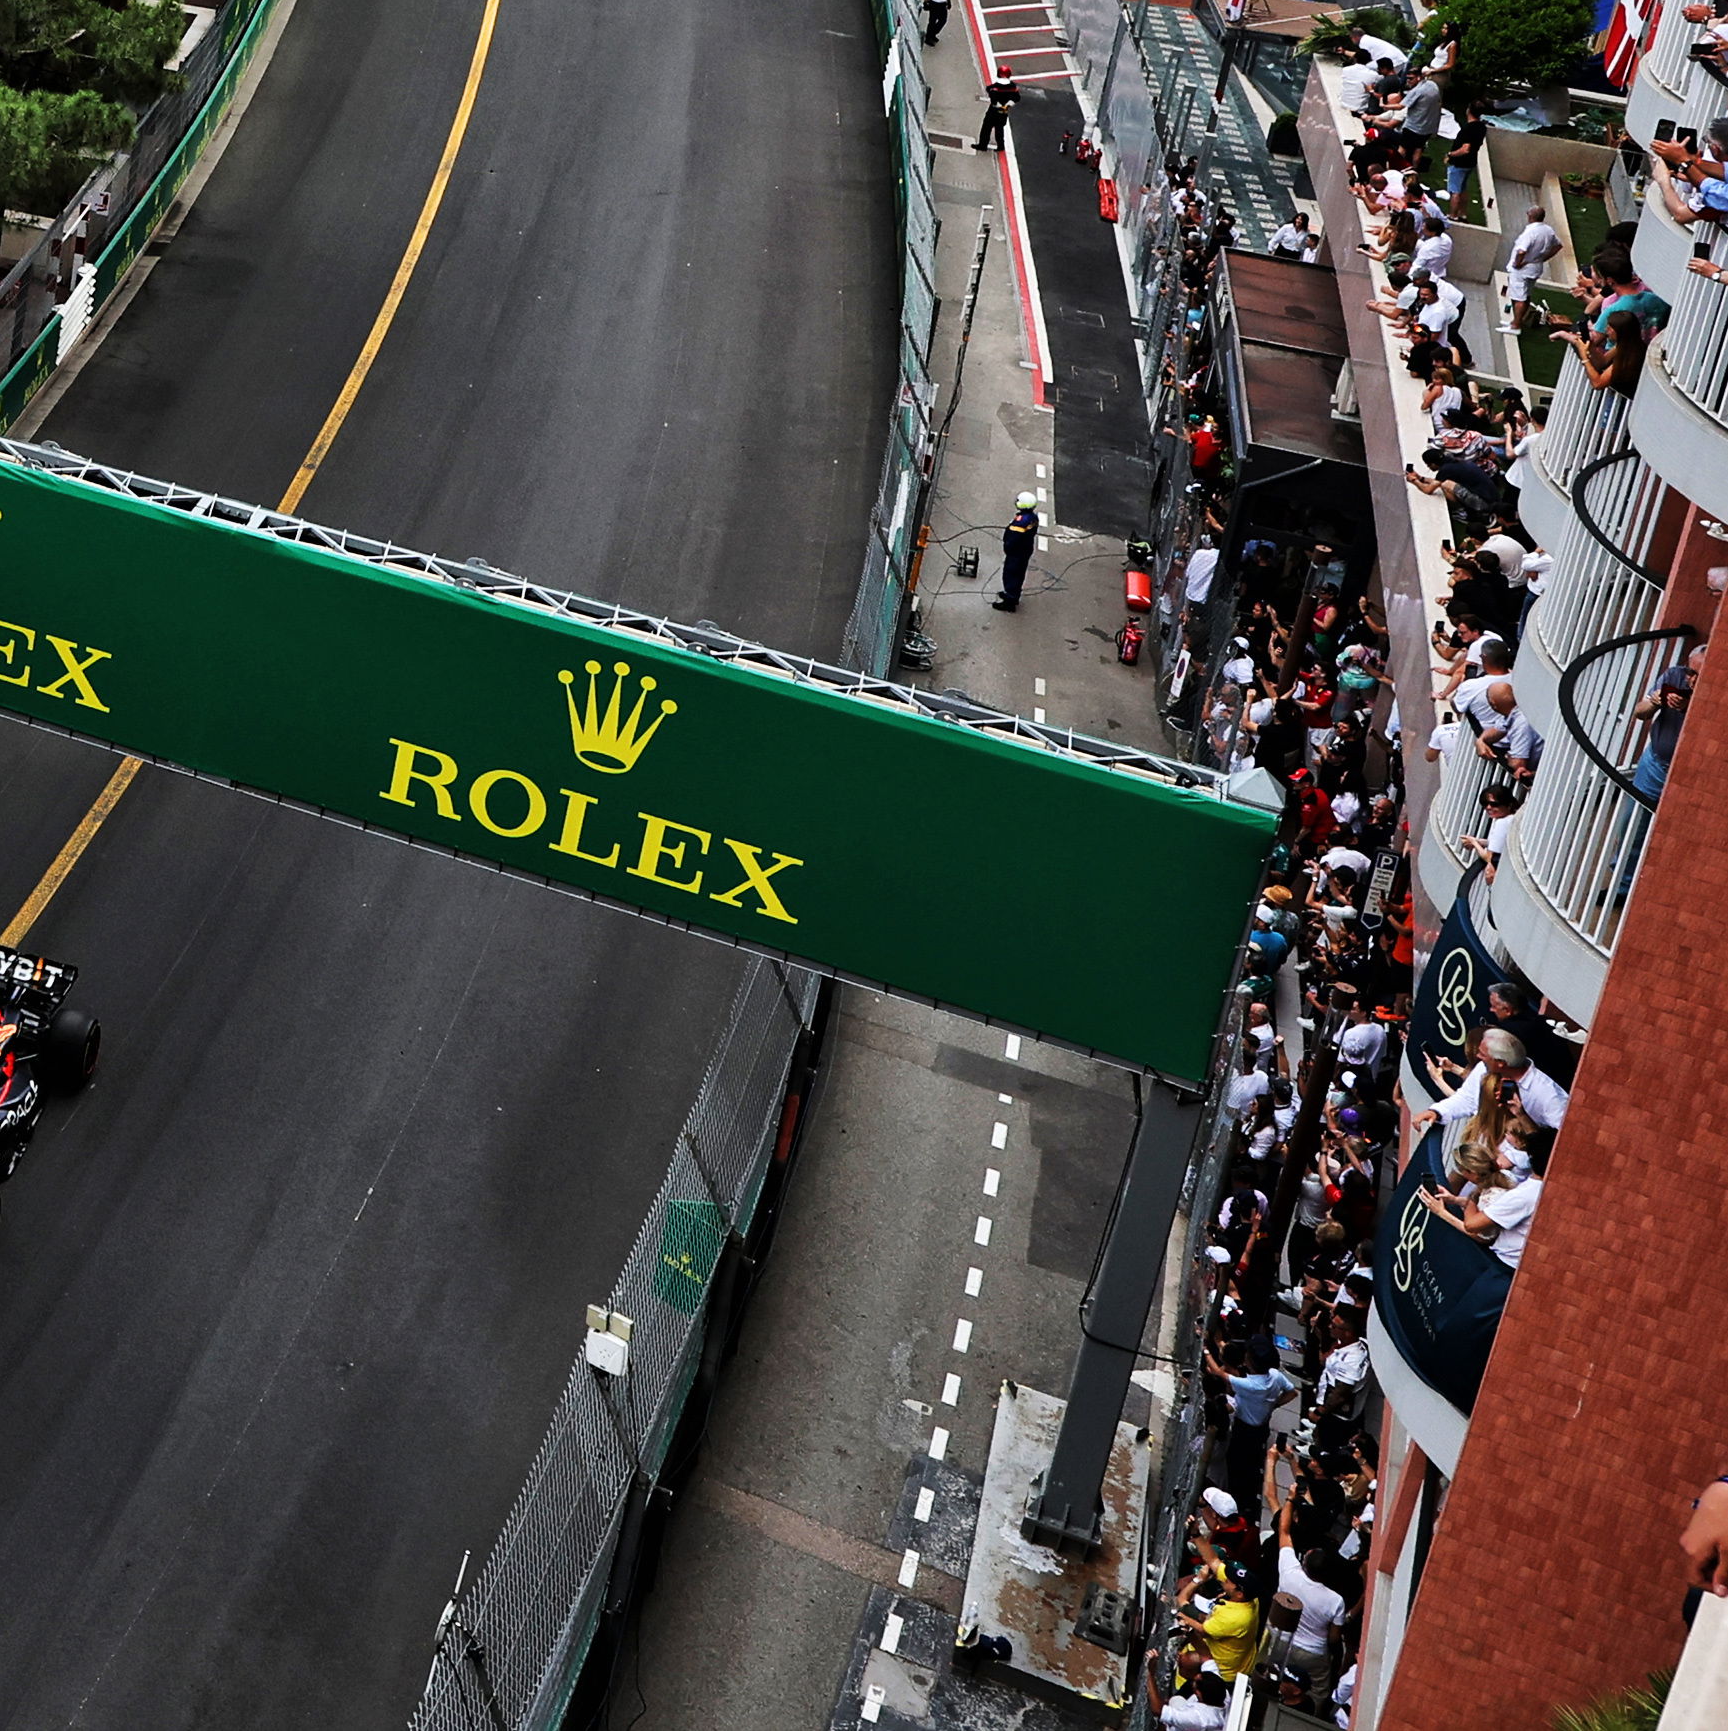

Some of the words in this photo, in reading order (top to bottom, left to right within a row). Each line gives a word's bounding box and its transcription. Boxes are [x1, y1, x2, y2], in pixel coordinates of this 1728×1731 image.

[380, 737, 804, 924] ROLEX
[1381, 856, 1393, 868] P
[1423, 1260, 1445, 1304] OCEAN
